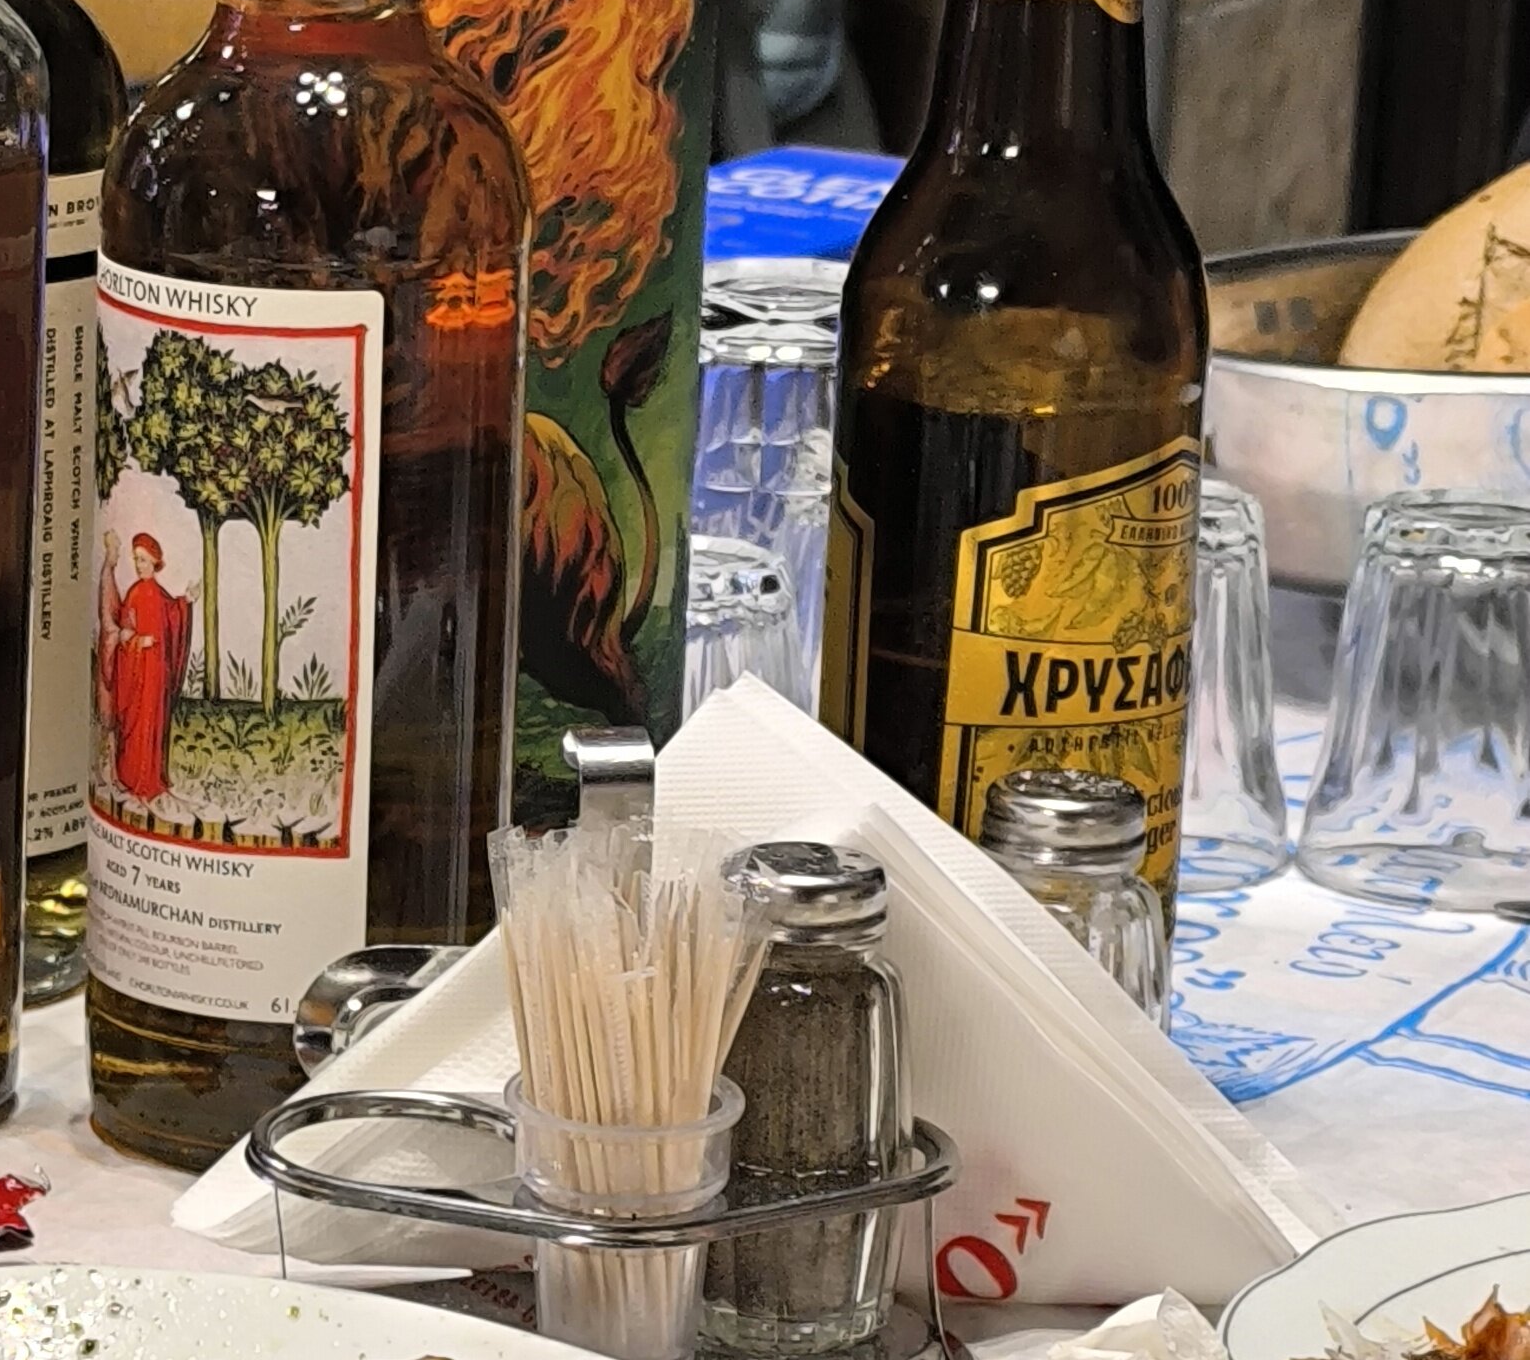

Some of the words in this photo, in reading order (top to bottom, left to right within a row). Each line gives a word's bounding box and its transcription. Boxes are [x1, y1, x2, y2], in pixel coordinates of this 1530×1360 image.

[66, 196, 99, 214] BRO
[166, 289, 258, 318] WHISKY
[45, 328, 56, 409] DISTILLED
[74, 325, 84, 382] SINGLE
[44, 419, 55, 439] AT
[73, 392, 83, 434] MALT
[43, 450, 54, 542] LAPHROAIG
[72, 445, 82, 509] SCOTCH
[70, 518, 80, 581] WHISKY
[41, 553, 53, 640] DISTILLERY
[126, 839, 181, 868] SCOTCH
[185, 855, 254, 878] WHISKY
[132, 864, 141, 886] 7
[145, 873, 181, 894] YEARS
[209, 917, 282, 935] DISTILLERY
[271, 998, 297, 1015] 61.
